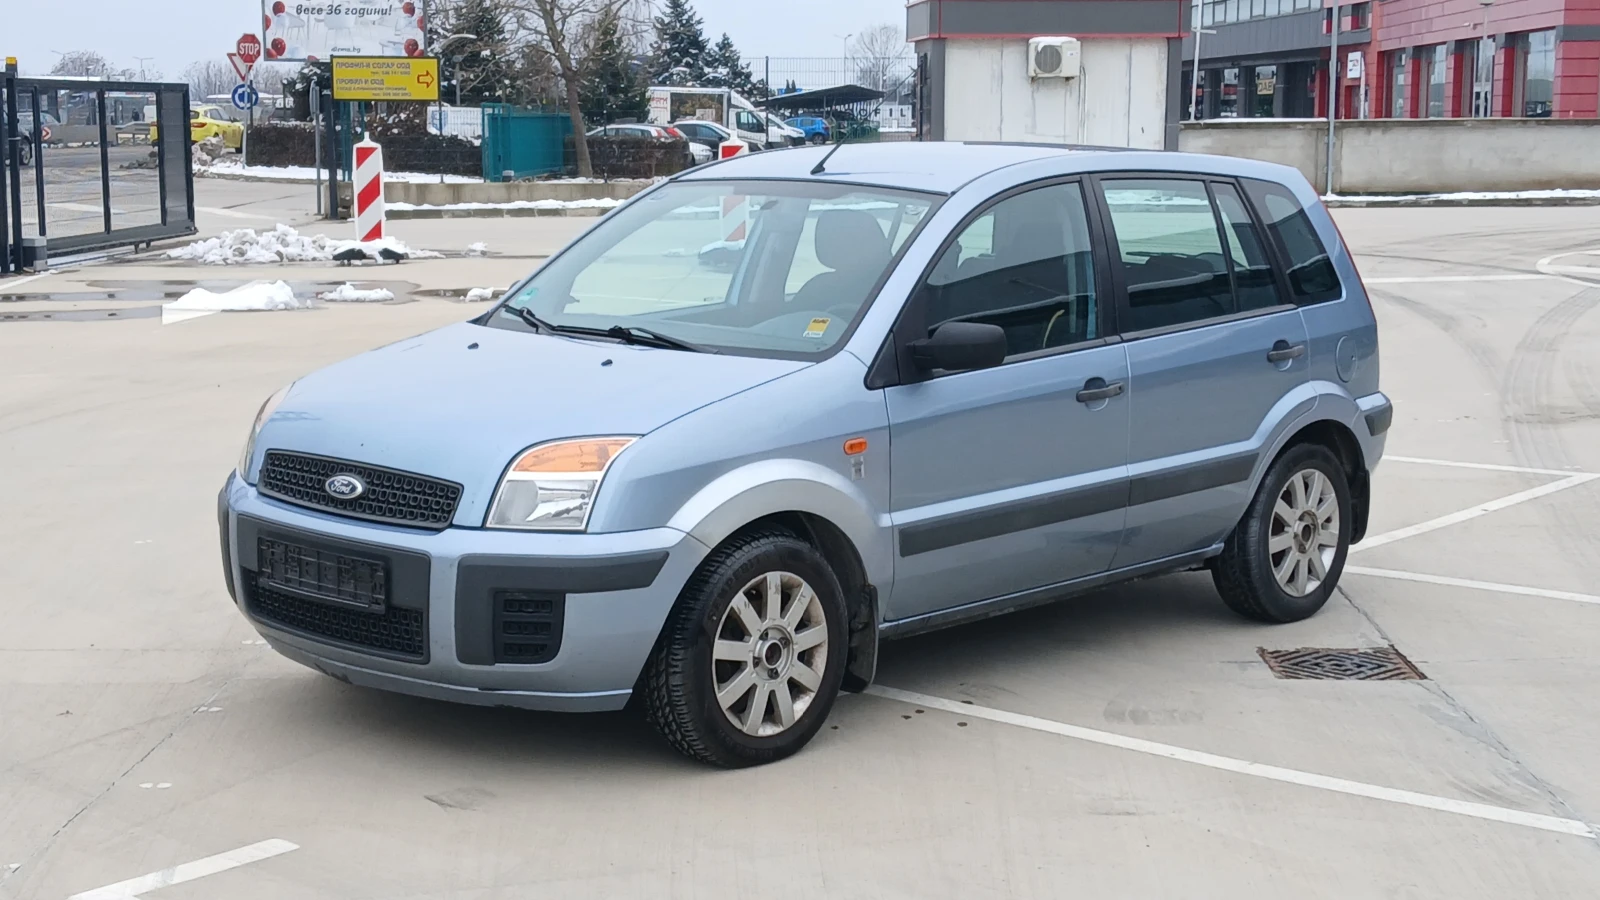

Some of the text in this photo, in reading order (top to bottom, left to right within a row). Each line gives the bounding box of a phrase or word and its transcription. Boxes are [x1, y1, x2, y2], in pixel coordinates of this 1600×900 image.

[326, 4, 341, 15] 36
[345, 5, 392, 18] години!
[239, 42, 260, 55] STOP
[331, 479, 352, 493] Ford
